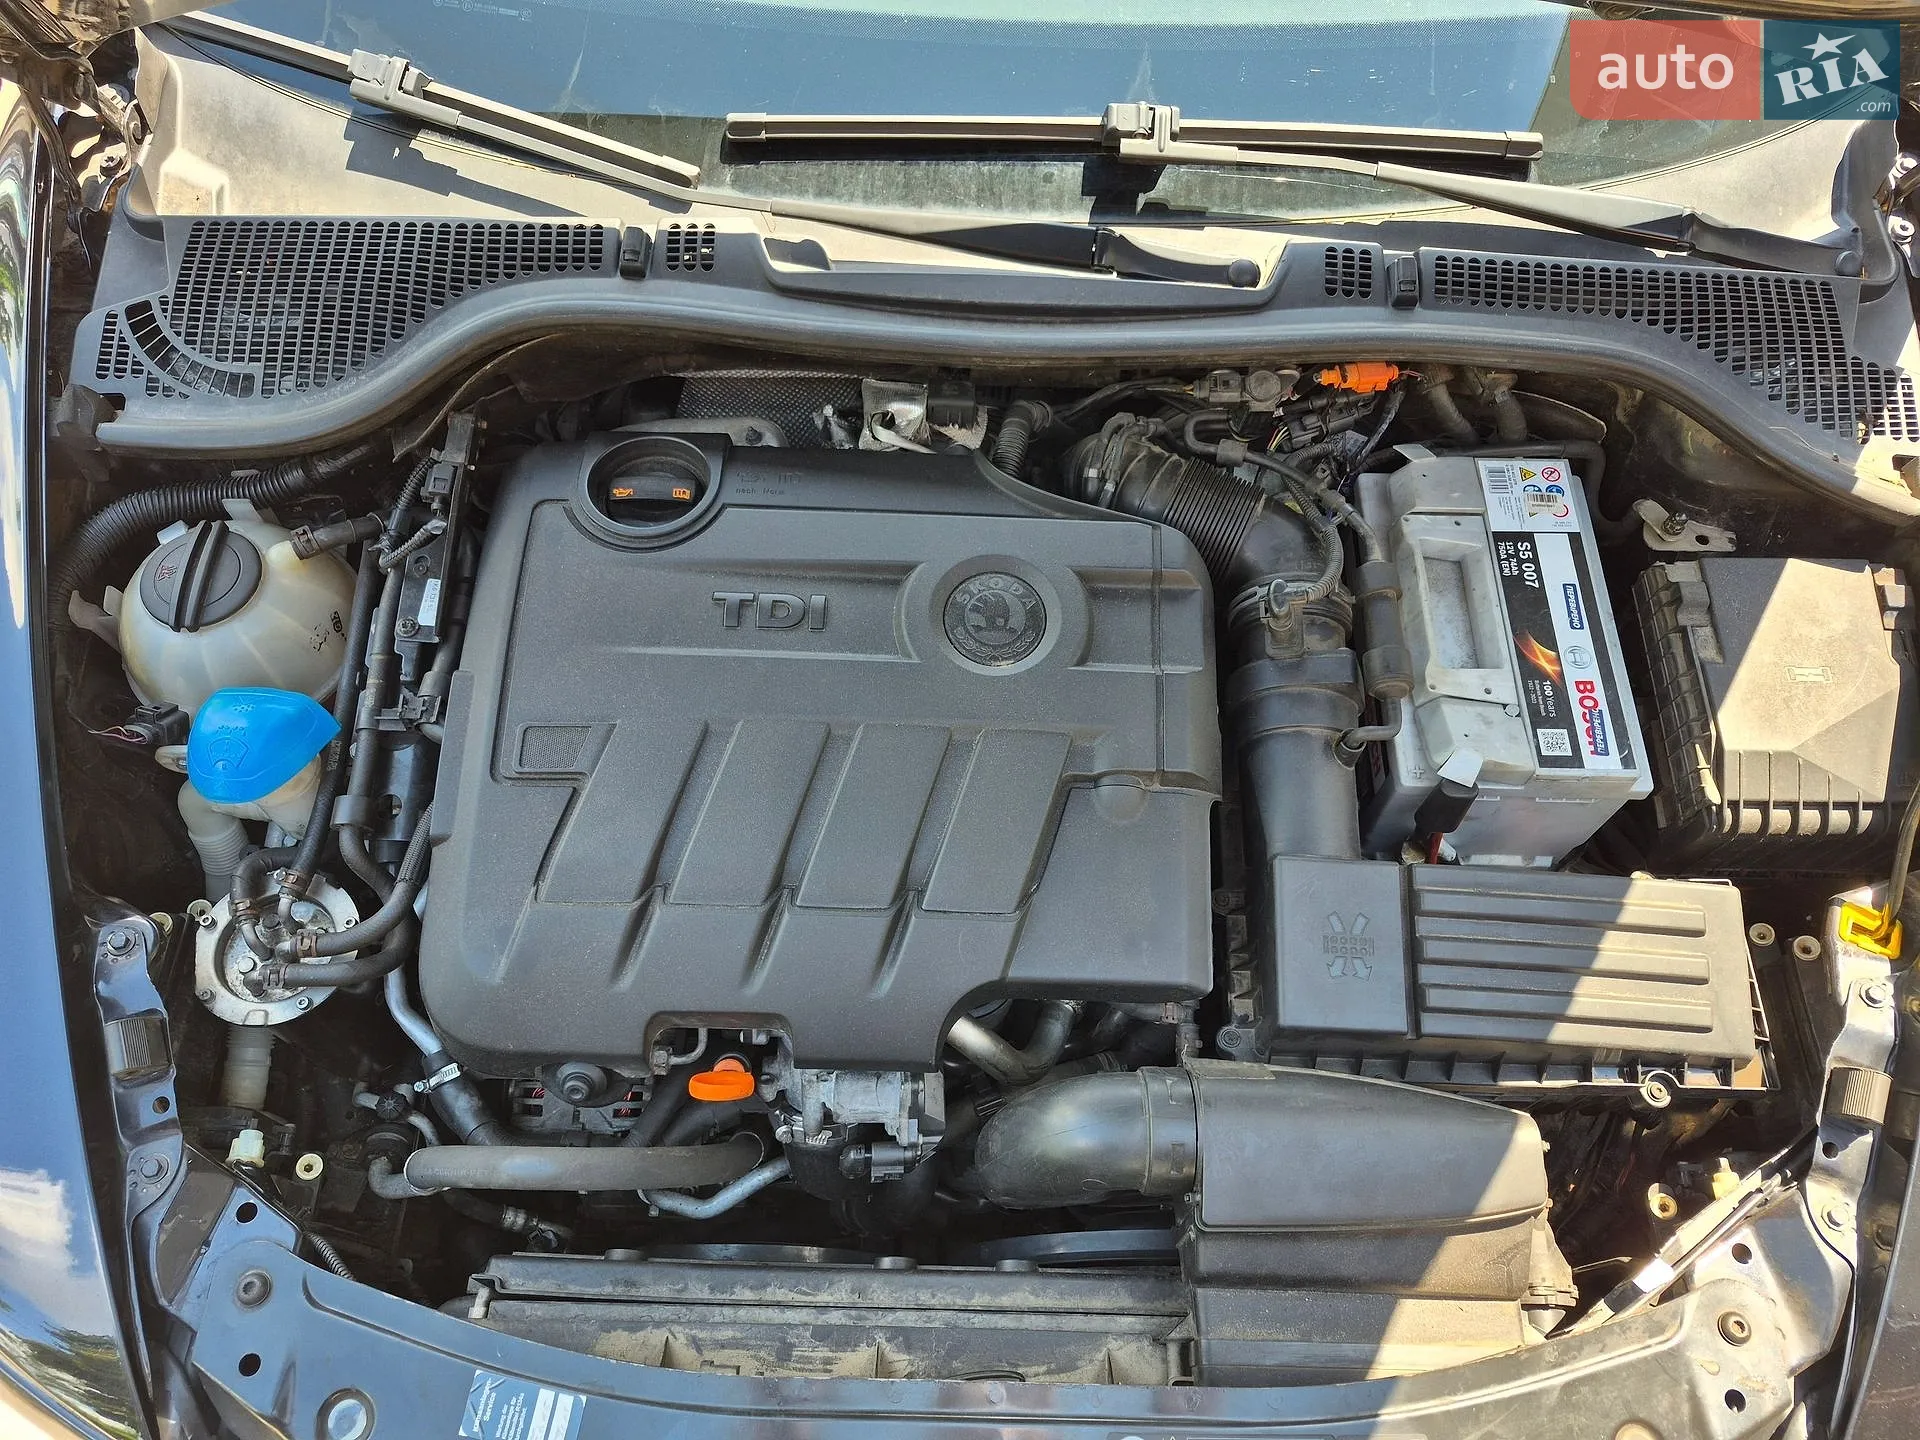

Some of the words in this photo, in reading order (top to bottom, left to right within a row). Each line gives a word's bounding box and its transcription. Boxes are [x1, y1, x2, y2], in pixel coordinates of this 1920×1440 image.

[1497, 541, 1508, 560] 750A
[1505, 541, 1516, 555] 12V
[1517, 541, 1533, 559] S5
[1500, 560, 1512, 577] (EN)
[1509, 558, 1520, 576] 74Ah
[1521, 562, 1540, 588] 007
[712, 592, 827, 631] TDI
[1542, 680, 1554, 697] 100
[1546, 696, 1557, 718] Years
